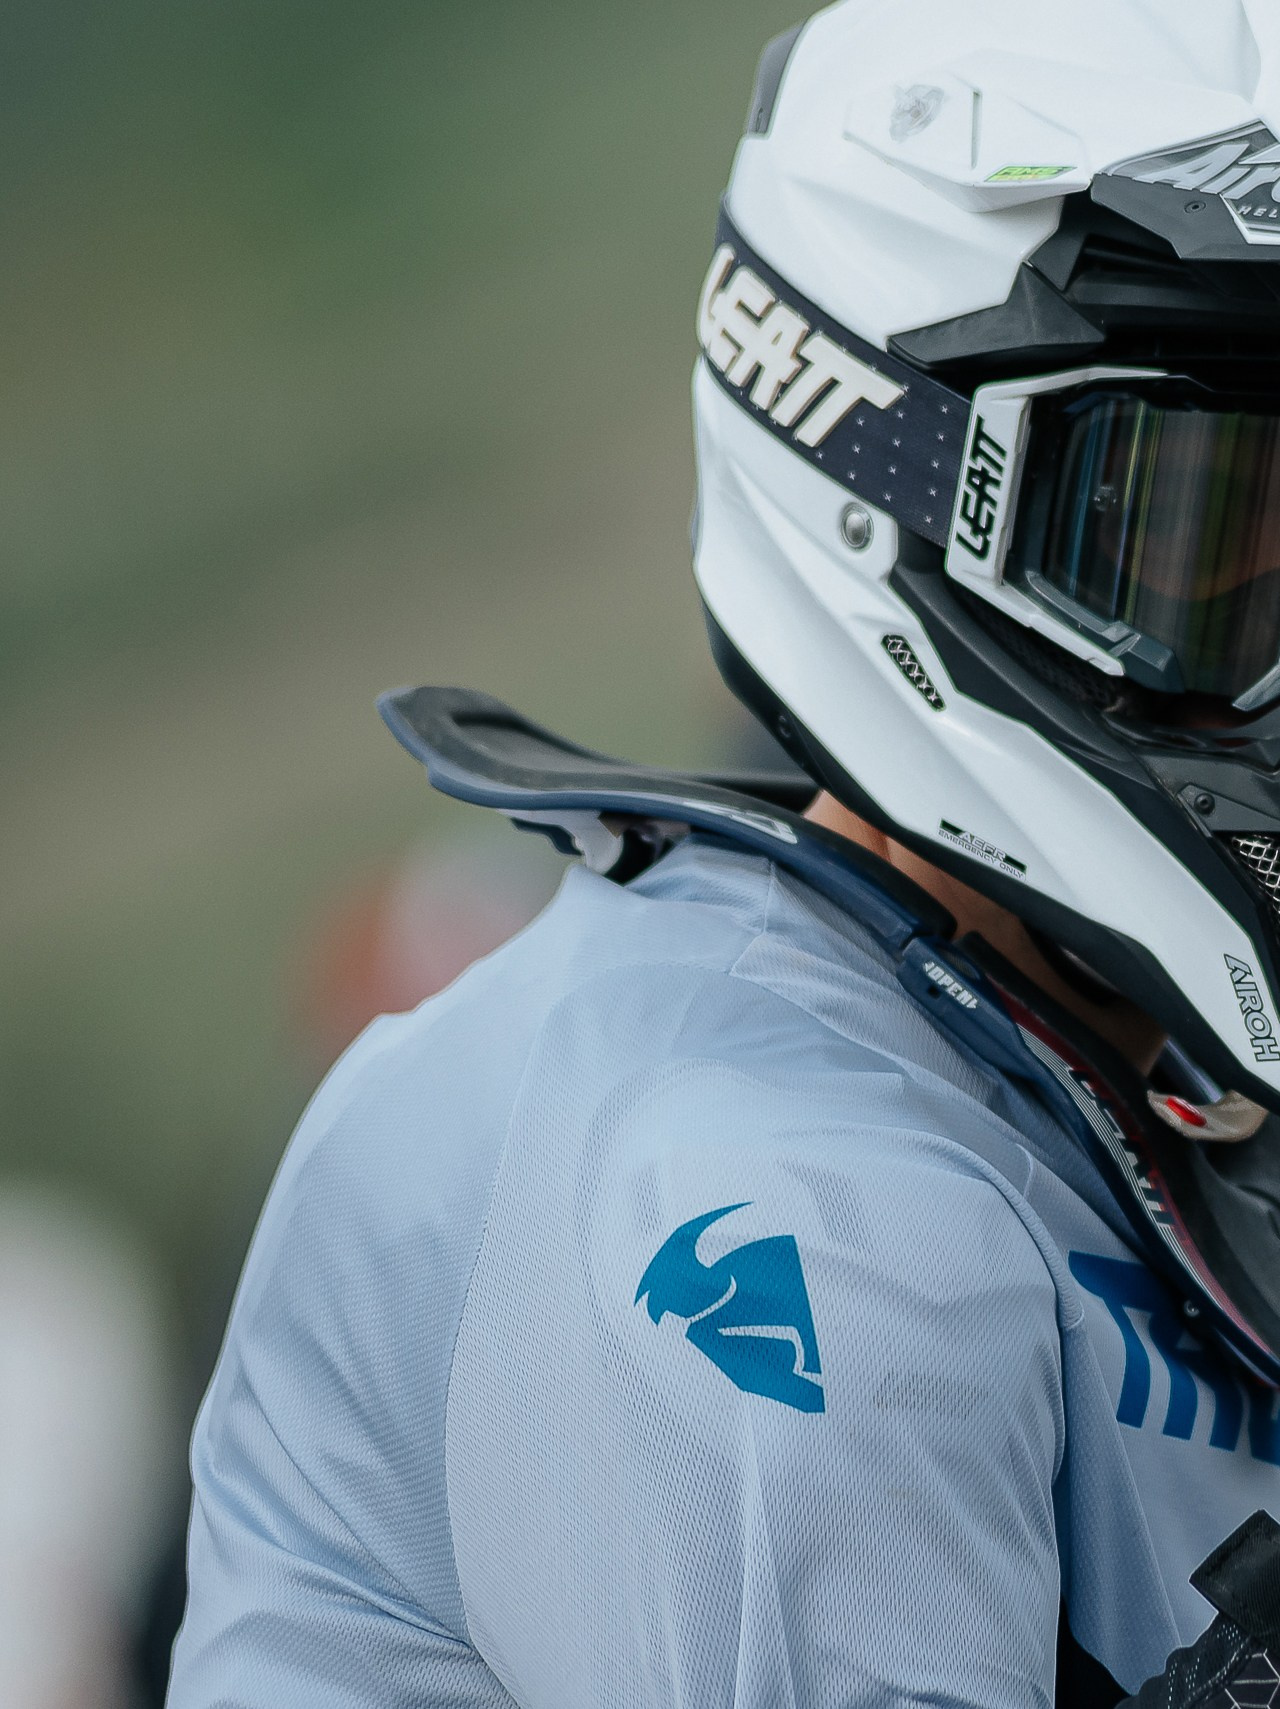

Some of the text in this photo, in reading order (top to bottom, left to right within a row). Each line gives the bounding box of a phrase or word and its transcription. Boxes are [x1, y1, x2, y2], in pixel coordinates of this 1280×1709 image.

[697, 246, 904, 447] LEATT
[955, 414, 1007, 560] LEATT
[938, 829, 1024, 879] EMERGENCY ONLY
[927, 965, 973, 1006] OPEN
